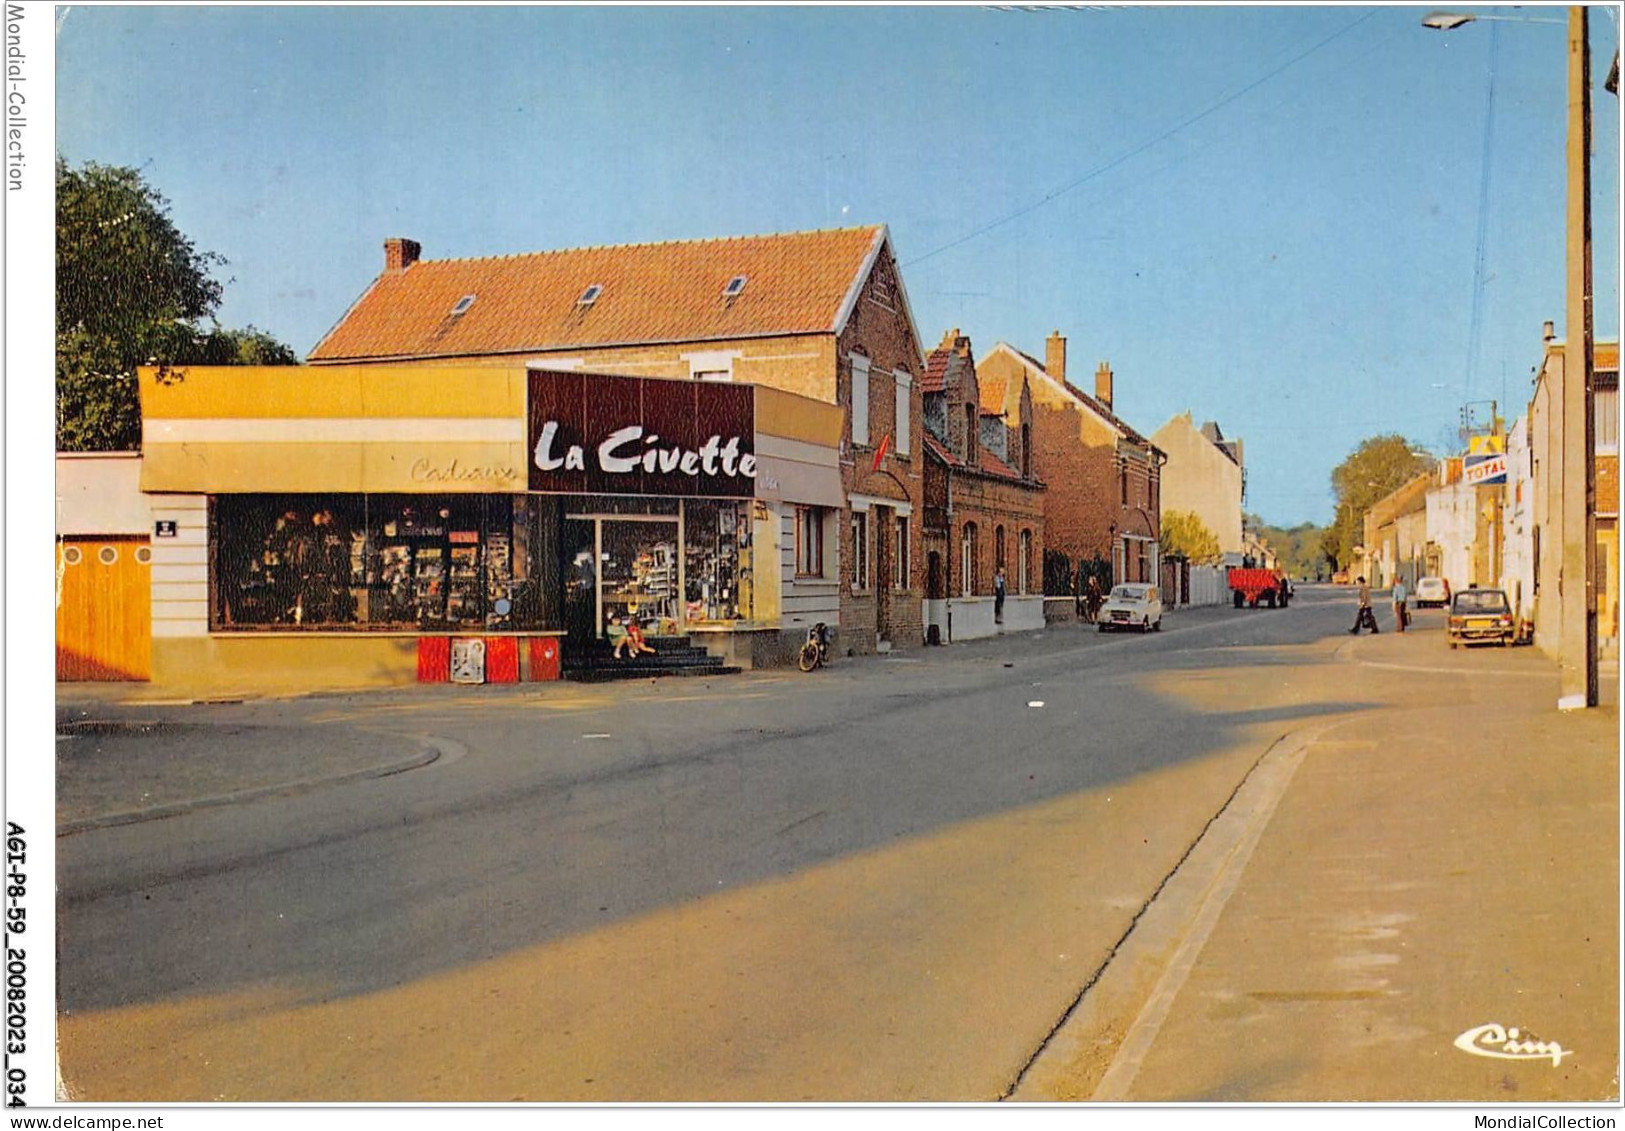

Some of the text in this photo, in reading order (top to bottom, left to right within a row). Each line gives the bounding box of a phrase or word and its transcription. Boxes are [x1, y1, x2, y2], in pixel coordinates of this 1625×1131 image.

[534, 421, 757, 478] La Civette
[1467, 460, 1505, 481] TOTAL
